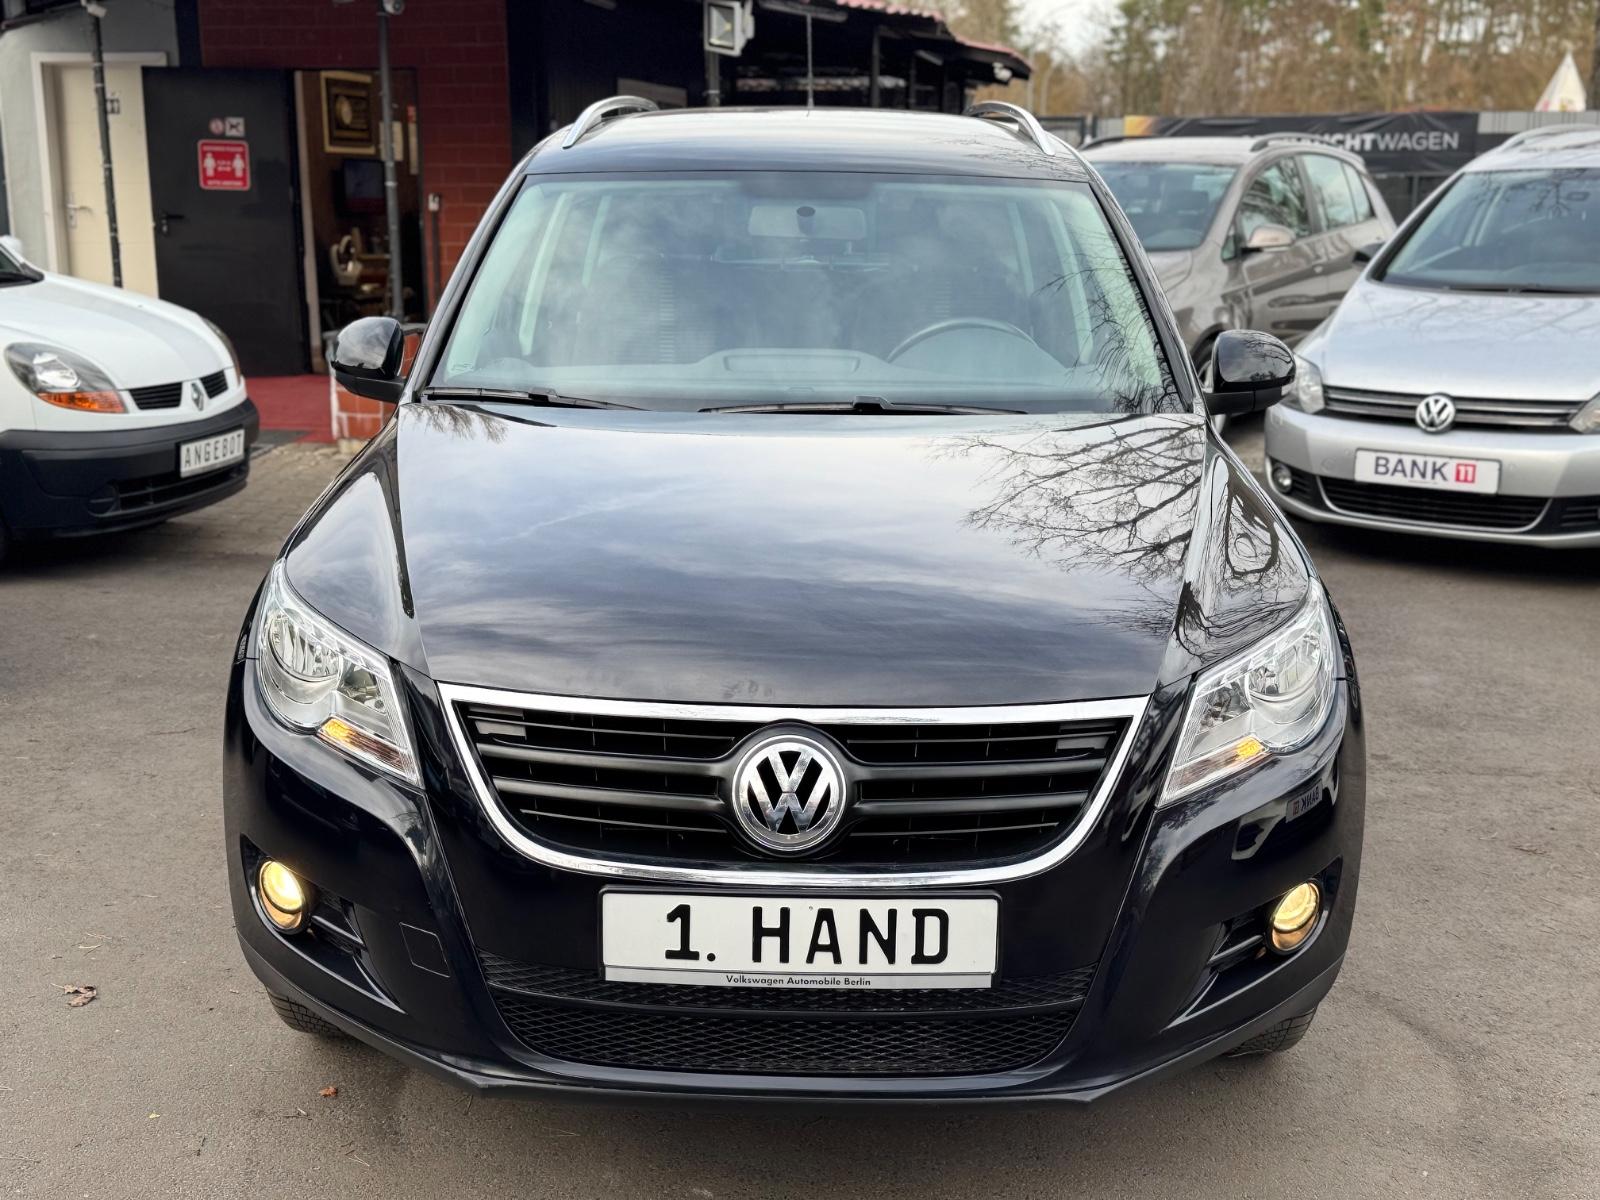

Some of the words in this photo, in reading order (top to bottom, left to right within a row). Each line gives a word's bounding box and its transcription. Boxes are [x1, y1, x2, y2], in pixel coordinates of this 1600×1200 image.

[1242, 132, 1460, 152] CHTWAGEN
[184, 432, 242, 468] ANGEBOT
[1374, 455, 1449, 482] BANK
[737, 740, 841, 846] VW
[665, 903, 716, 963] 1.
[752, 905, 950, 965] HAND
[726, 974, 784, 986] Volkswagen
[786, 976, 841, 986] Automobile
[844, 977, 871, 986] Berlin
